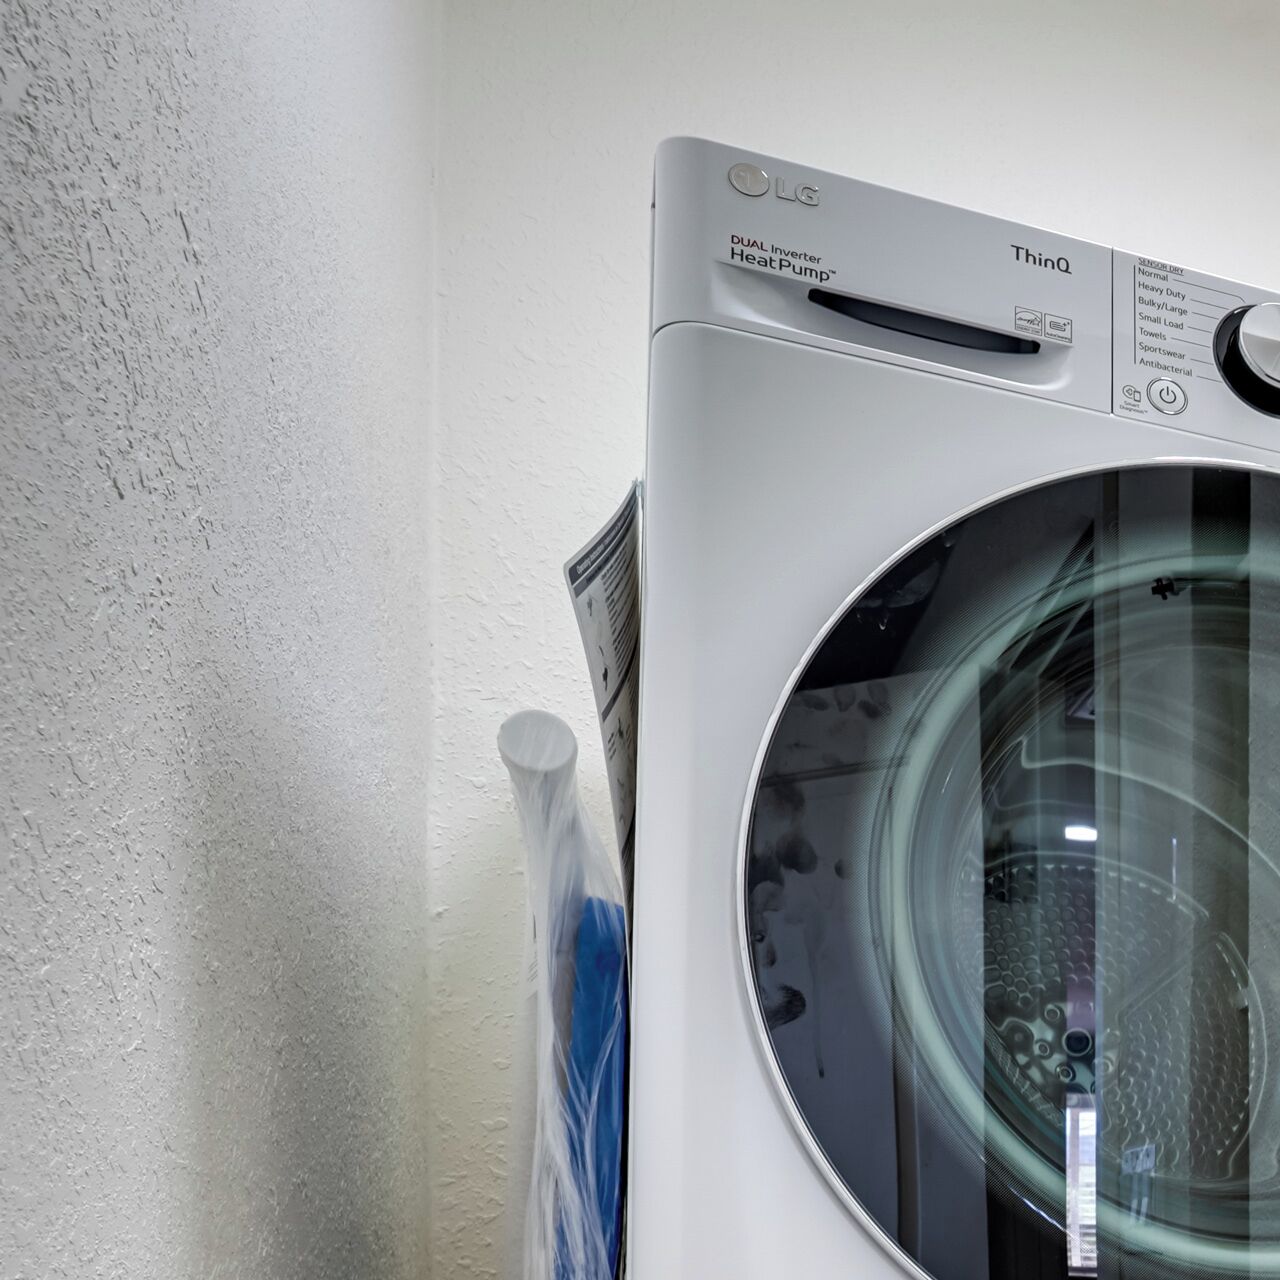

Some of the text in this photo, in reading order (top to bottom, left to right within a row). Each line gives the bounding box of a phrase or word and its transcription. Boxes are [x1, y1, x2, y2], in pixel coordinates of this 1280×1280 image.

[776, 176, 819, 207] LG
[730, 234, 822, 264] DUAL Inverter
[1010, 244, 1072, 275] ThinQ
[1138, 257, 1184, 275] SENSOR DRY
[1138, 266, 1169, 282] Normal
[1138, 281, 1186, 301] Heavy Duty
[1138, 296, 1188, 316] Bulky/Large
[1138, 311, 1184, 330] Small Load
[1139, 326, 1167, 341] Towels
[1138, 341, 1186, 360] Sportswear
[1139, 357, 1193, 377] Antibacterial
